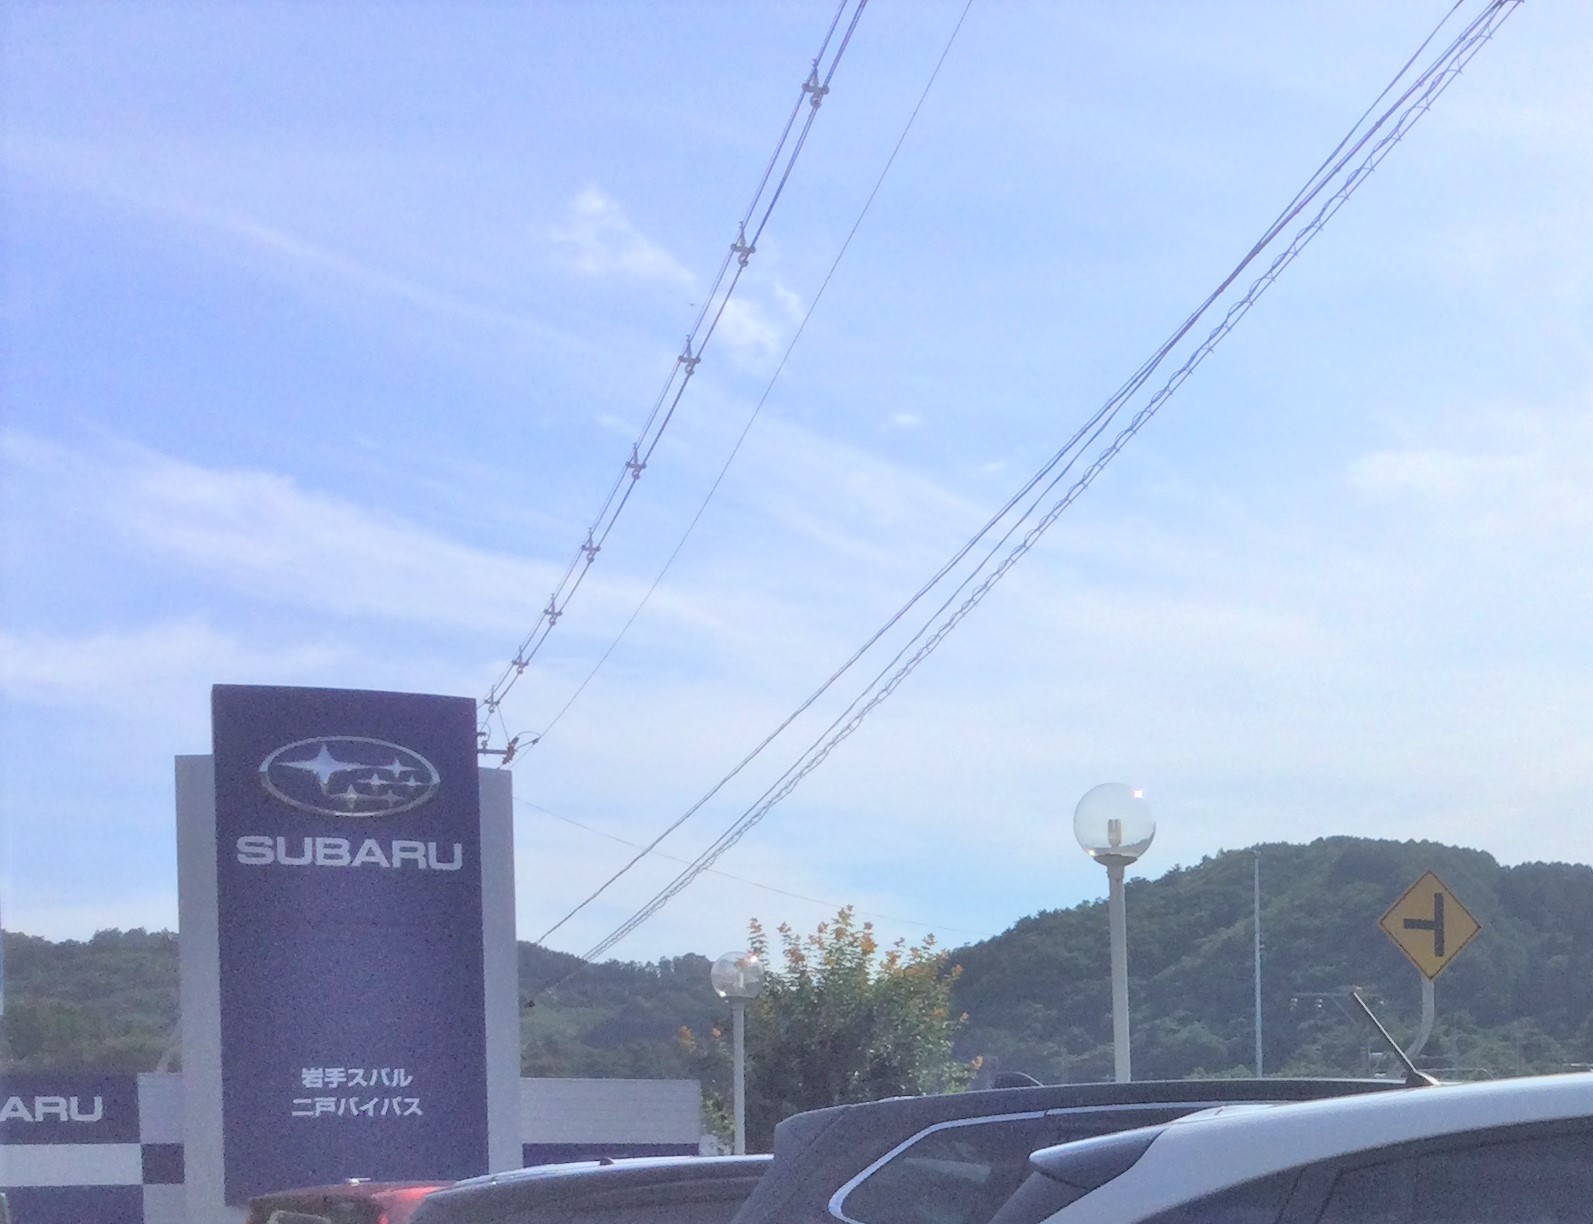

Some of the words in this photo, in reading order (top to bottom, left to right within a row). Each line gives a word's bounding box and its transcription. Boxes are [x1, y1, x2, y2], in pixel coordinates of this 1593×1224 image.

[236, 835, 463, 871] SUBARU
[301, 1067, 413, 1088] 岩手スバル
[0, 1095, 103, 1122] ARU
[291, 1096, 423, 1117] 二戸バイパス
